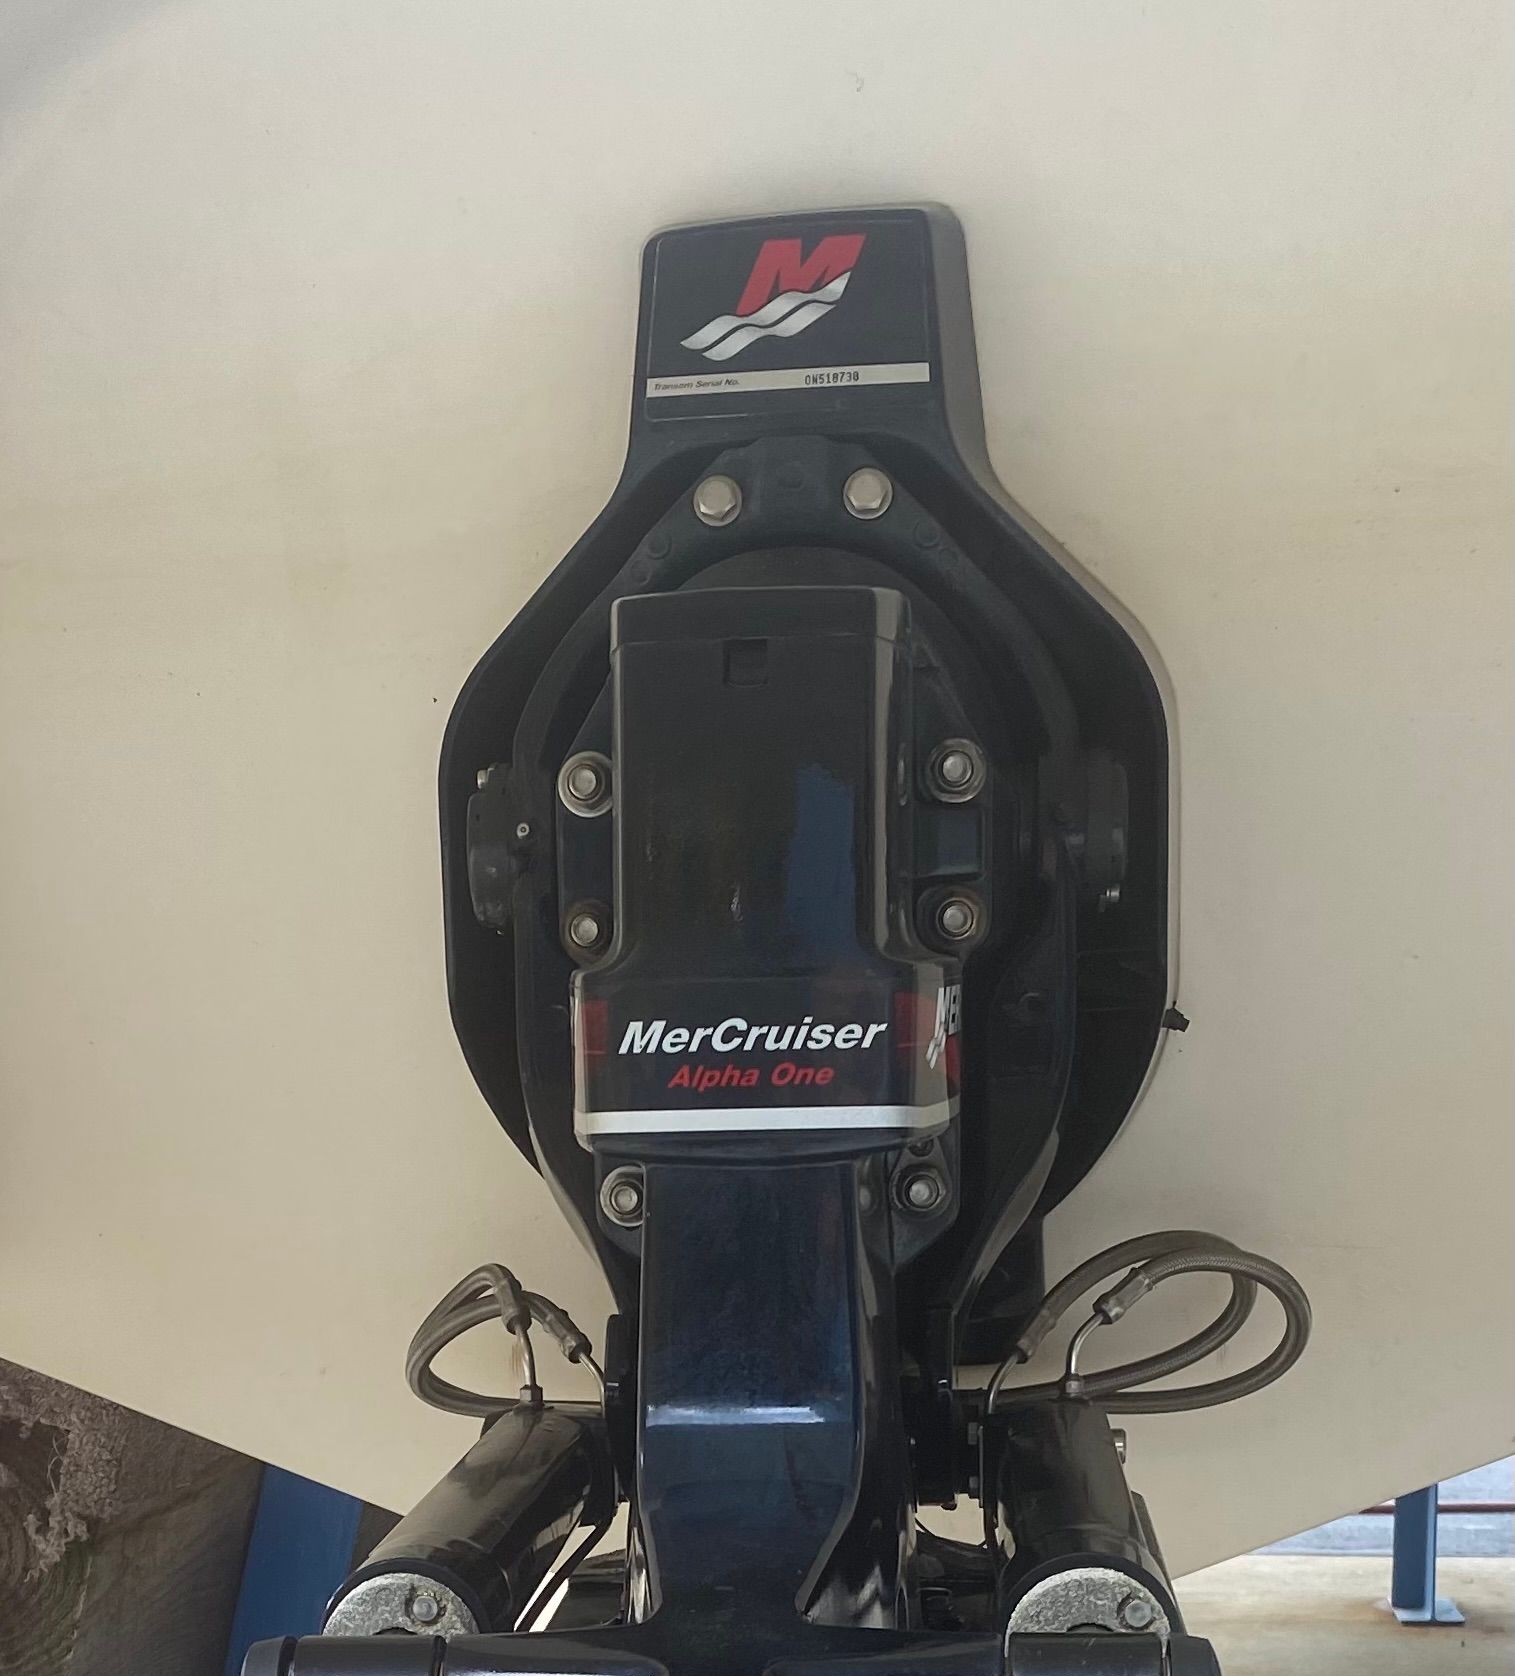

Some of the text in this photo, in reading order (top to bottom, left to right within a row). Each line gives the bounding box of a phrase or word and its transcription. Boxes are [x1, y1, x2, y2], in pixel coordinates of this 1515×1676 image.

[736, 234, 867, 318] M
[654, 377, 740, 391] Transom Serial No.
[618, 1015, 888, 1055] MerCruiser
[668, 1061, 835, 1093] Alpha One
